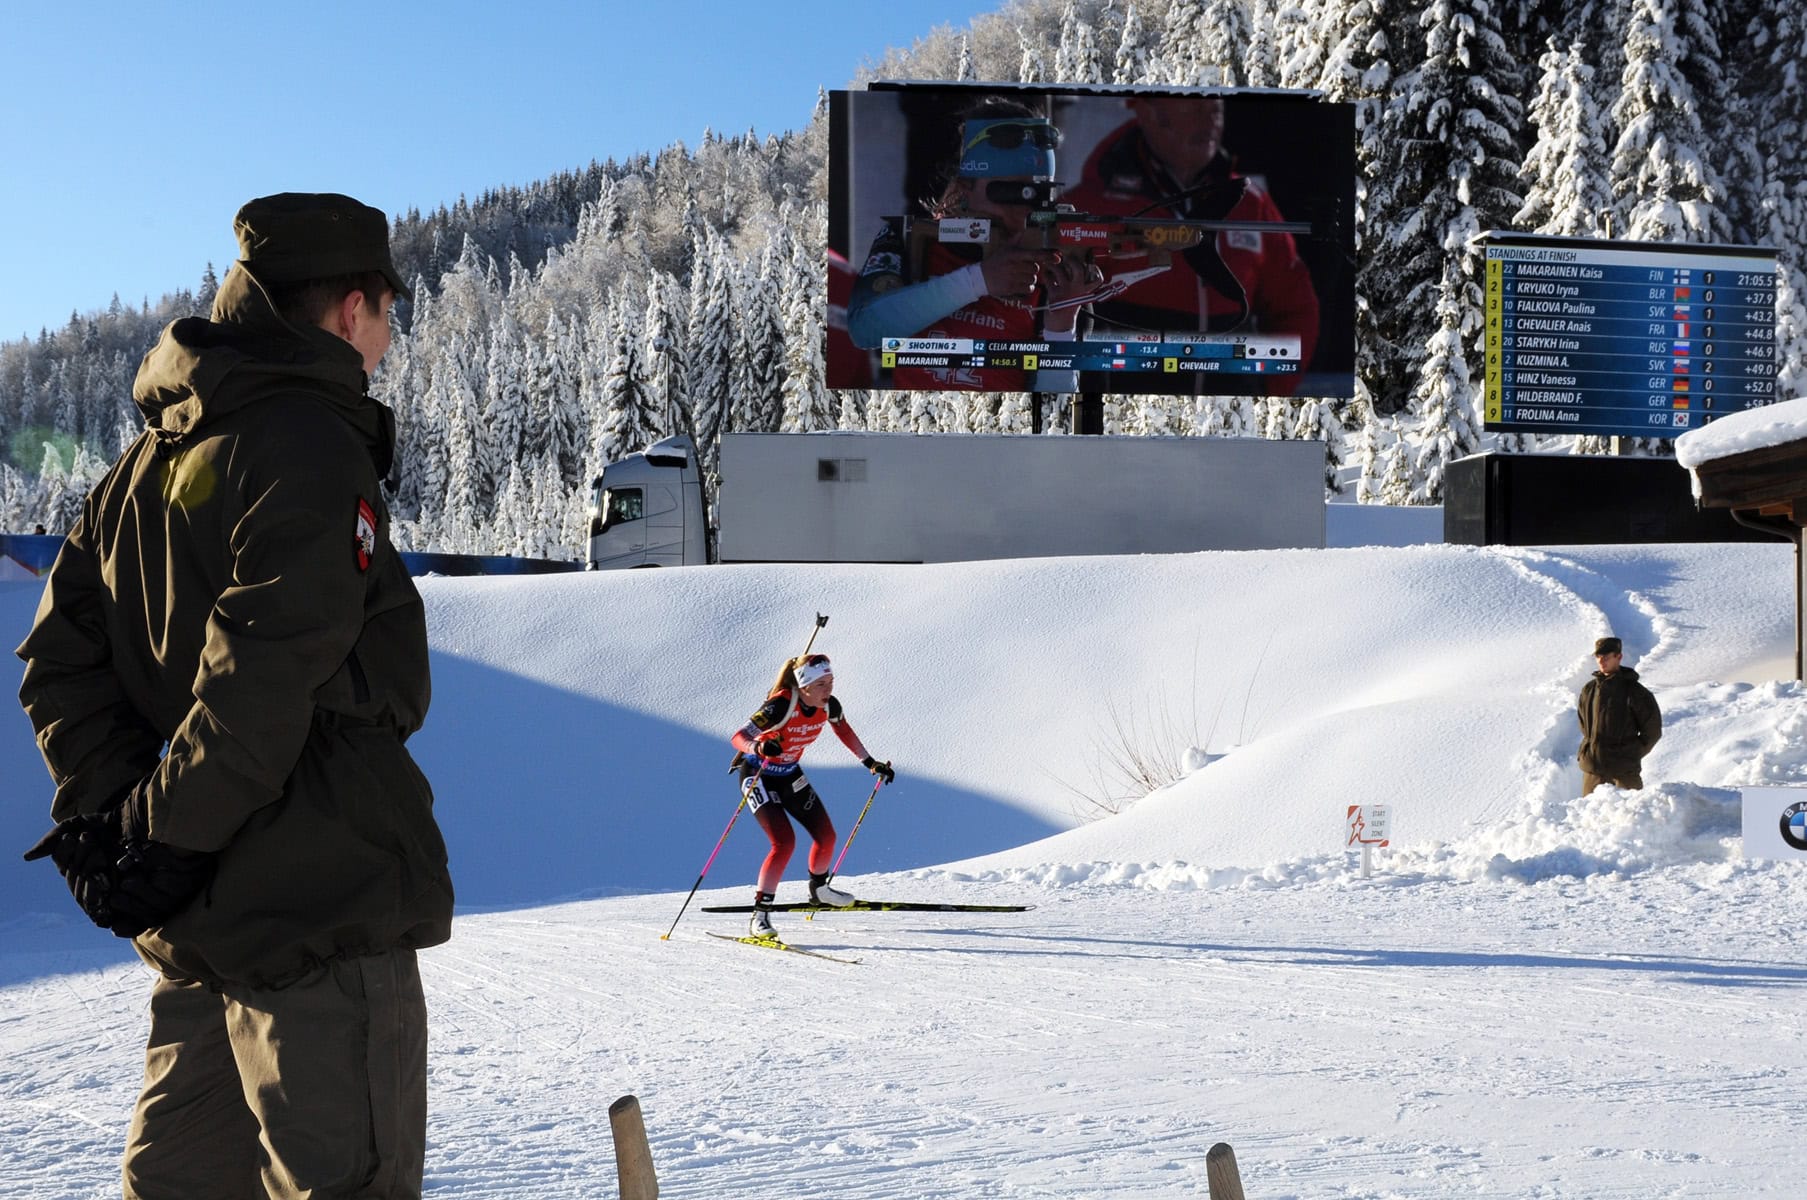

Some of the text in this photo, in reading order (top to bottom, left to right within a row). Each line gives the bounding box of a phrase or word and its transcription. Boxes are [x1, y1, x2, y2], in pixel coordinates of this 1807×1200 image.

[1060, 226, 1107, 241] VIESSMANN
[1489, 248, 1577, 262] STANDINGS AT FINISH
[1492, 264, 1773, 287] 1 22 MAKARAINEN Kaisa FIN 1 21:05.5
[1491, 281, 1773, 304] 2 4 KRYUKO Iryna BLR 0 +37.9
[1491, 300, 1773, 322] 3 10 FIALKOVA Paulina SVK 1 +43.2
[1490, 317, 1773, 340] 4 13 CHEVALIER Anais FRA 1 +44.8
[908, 342, 949, 350] SHOOTING
[988, 343, 1008, 351] CELIA
[1009, 343, 1049, 352] AYMONIER
[1490, 336, 1773, 358] 5 20 STARYKH Irina RUS 0 +46.9
[898, 357, 948, 366] MAKARAINEN
[1039, 360, 1072, 368] HOJNISZ
[1179, 362, 1220, 371] CHEVALIER
[1276, 364, 1297, 372] +23.5
[1490, 354, 1772, 375] 6 2 KUZMINA A. SVK 2 +49.0
[1490, 372, 1772, 393] 7 15 HINZ Vanessa GER 0 +52.0
[1490, 390, 1496, 401] 8
[1505, 392, 1510, 400] 5
[1516, 391, 1575, 403] HILDEBRAND
[1576, 393, 1584, 404] F.
[1649, 395, 1666, 407] GER
[1706, 398, 1711, 408] 1
[1490, 408, 1496, 418] 9
[1503, 410, 1512, 418] 11
[1516, 409, 1555, 421] FROLINA
[1556, 410, 1580, 422] Anna
[1648, 413, 1667, 424] KOR
